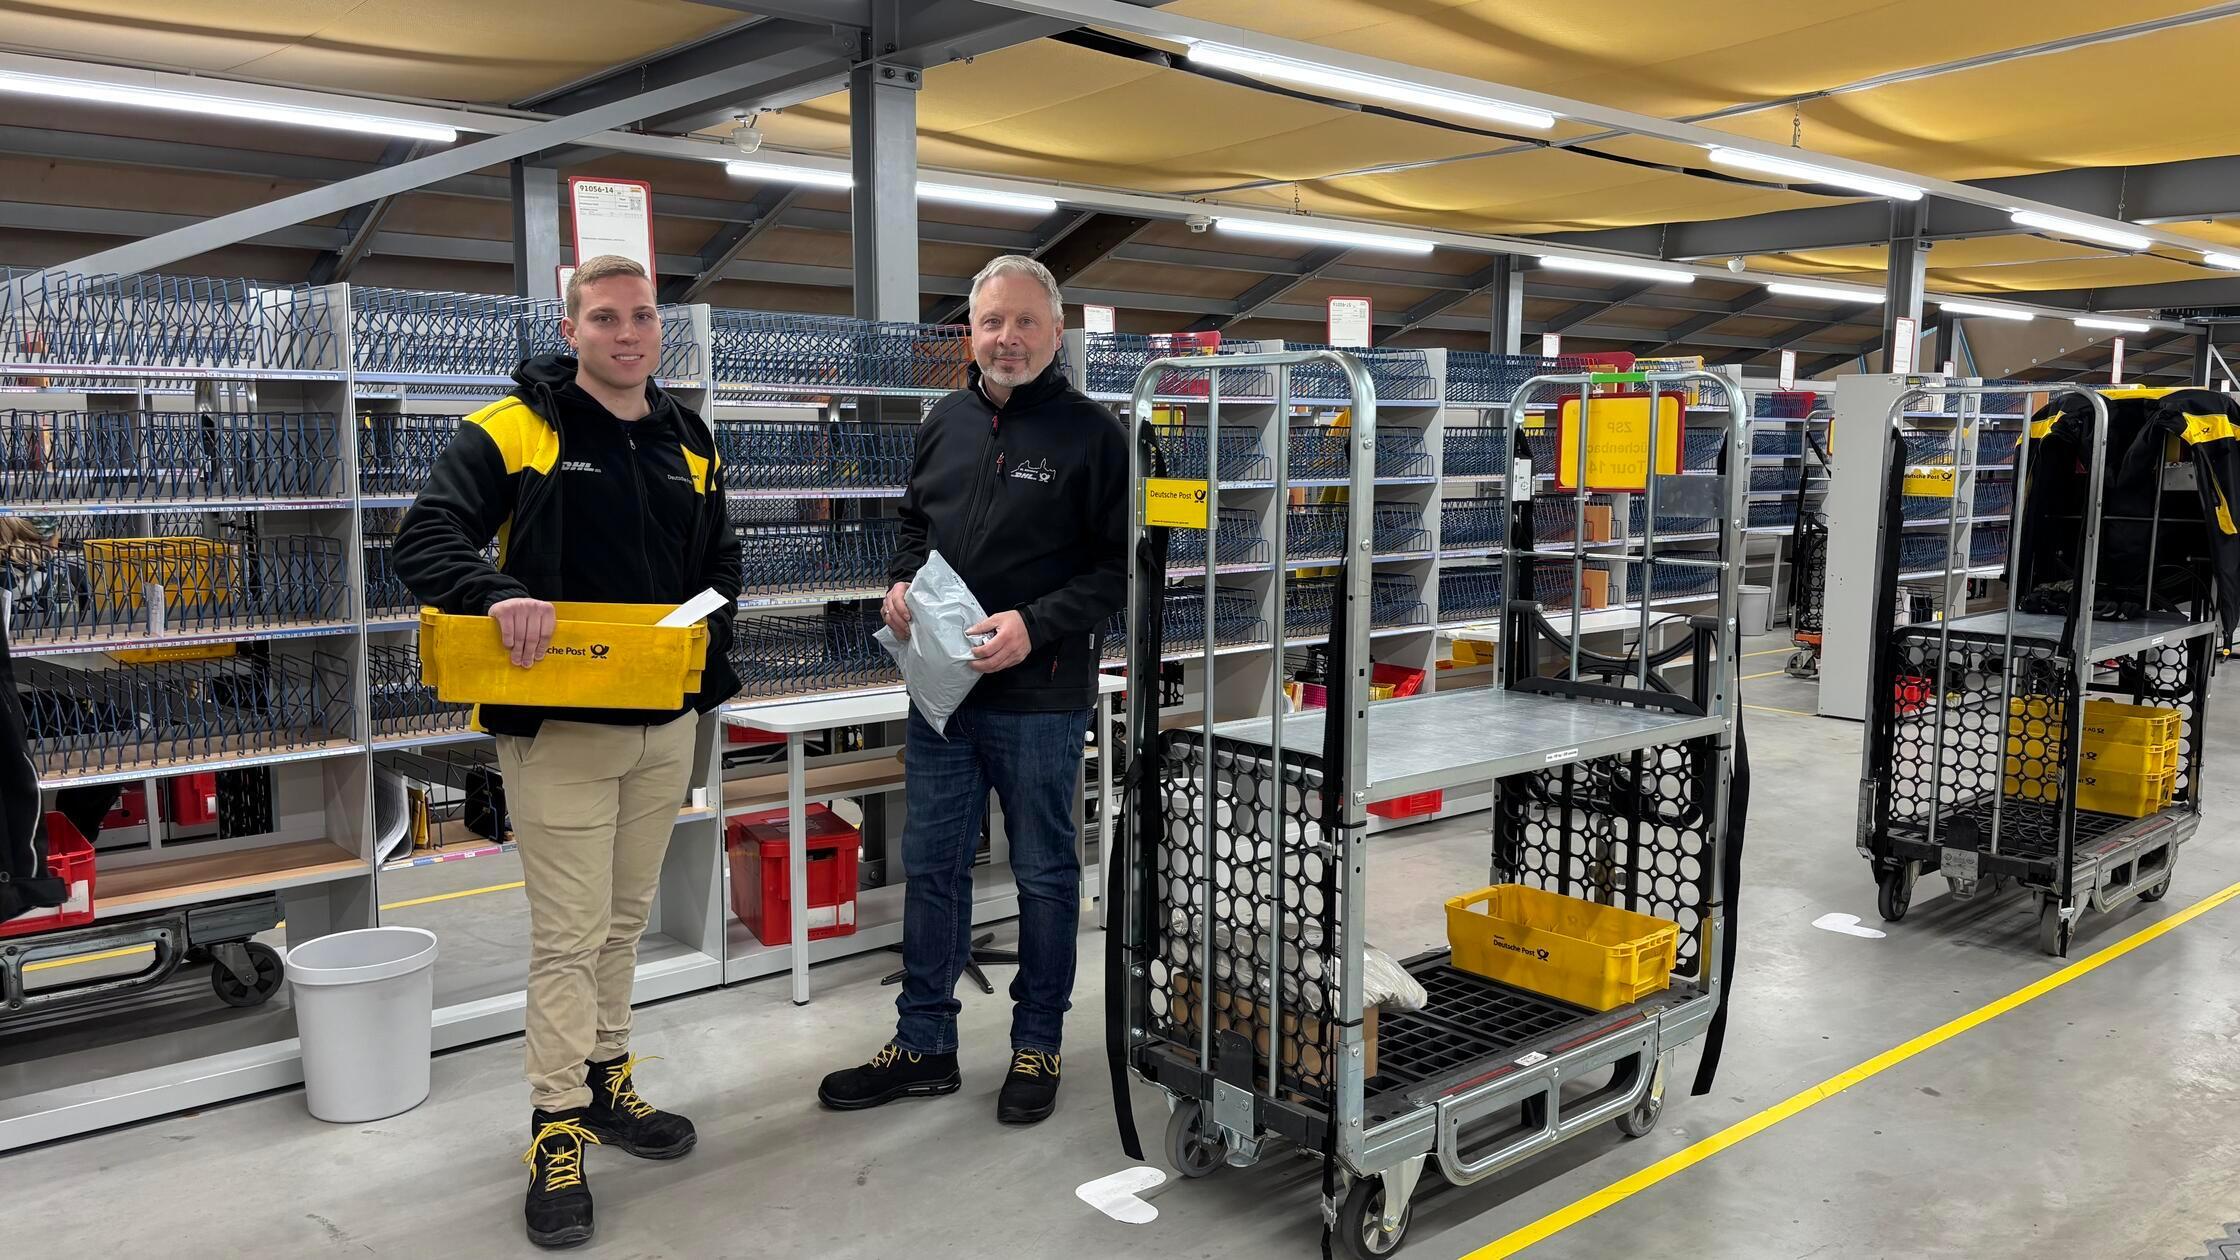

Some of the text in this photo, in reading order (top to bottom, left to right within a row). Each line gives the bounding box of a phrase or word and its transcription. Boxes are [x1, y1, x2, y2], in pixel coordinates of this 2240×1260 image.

[579, 184, 614, 194] 91056-14
[561, 461, 595, 472] DHL
[1150, 490, 1192, 500] Deutsche Post
[565, 647, 586, 656] Post
[1493, 939, 1536, 957] Deutsche Post
